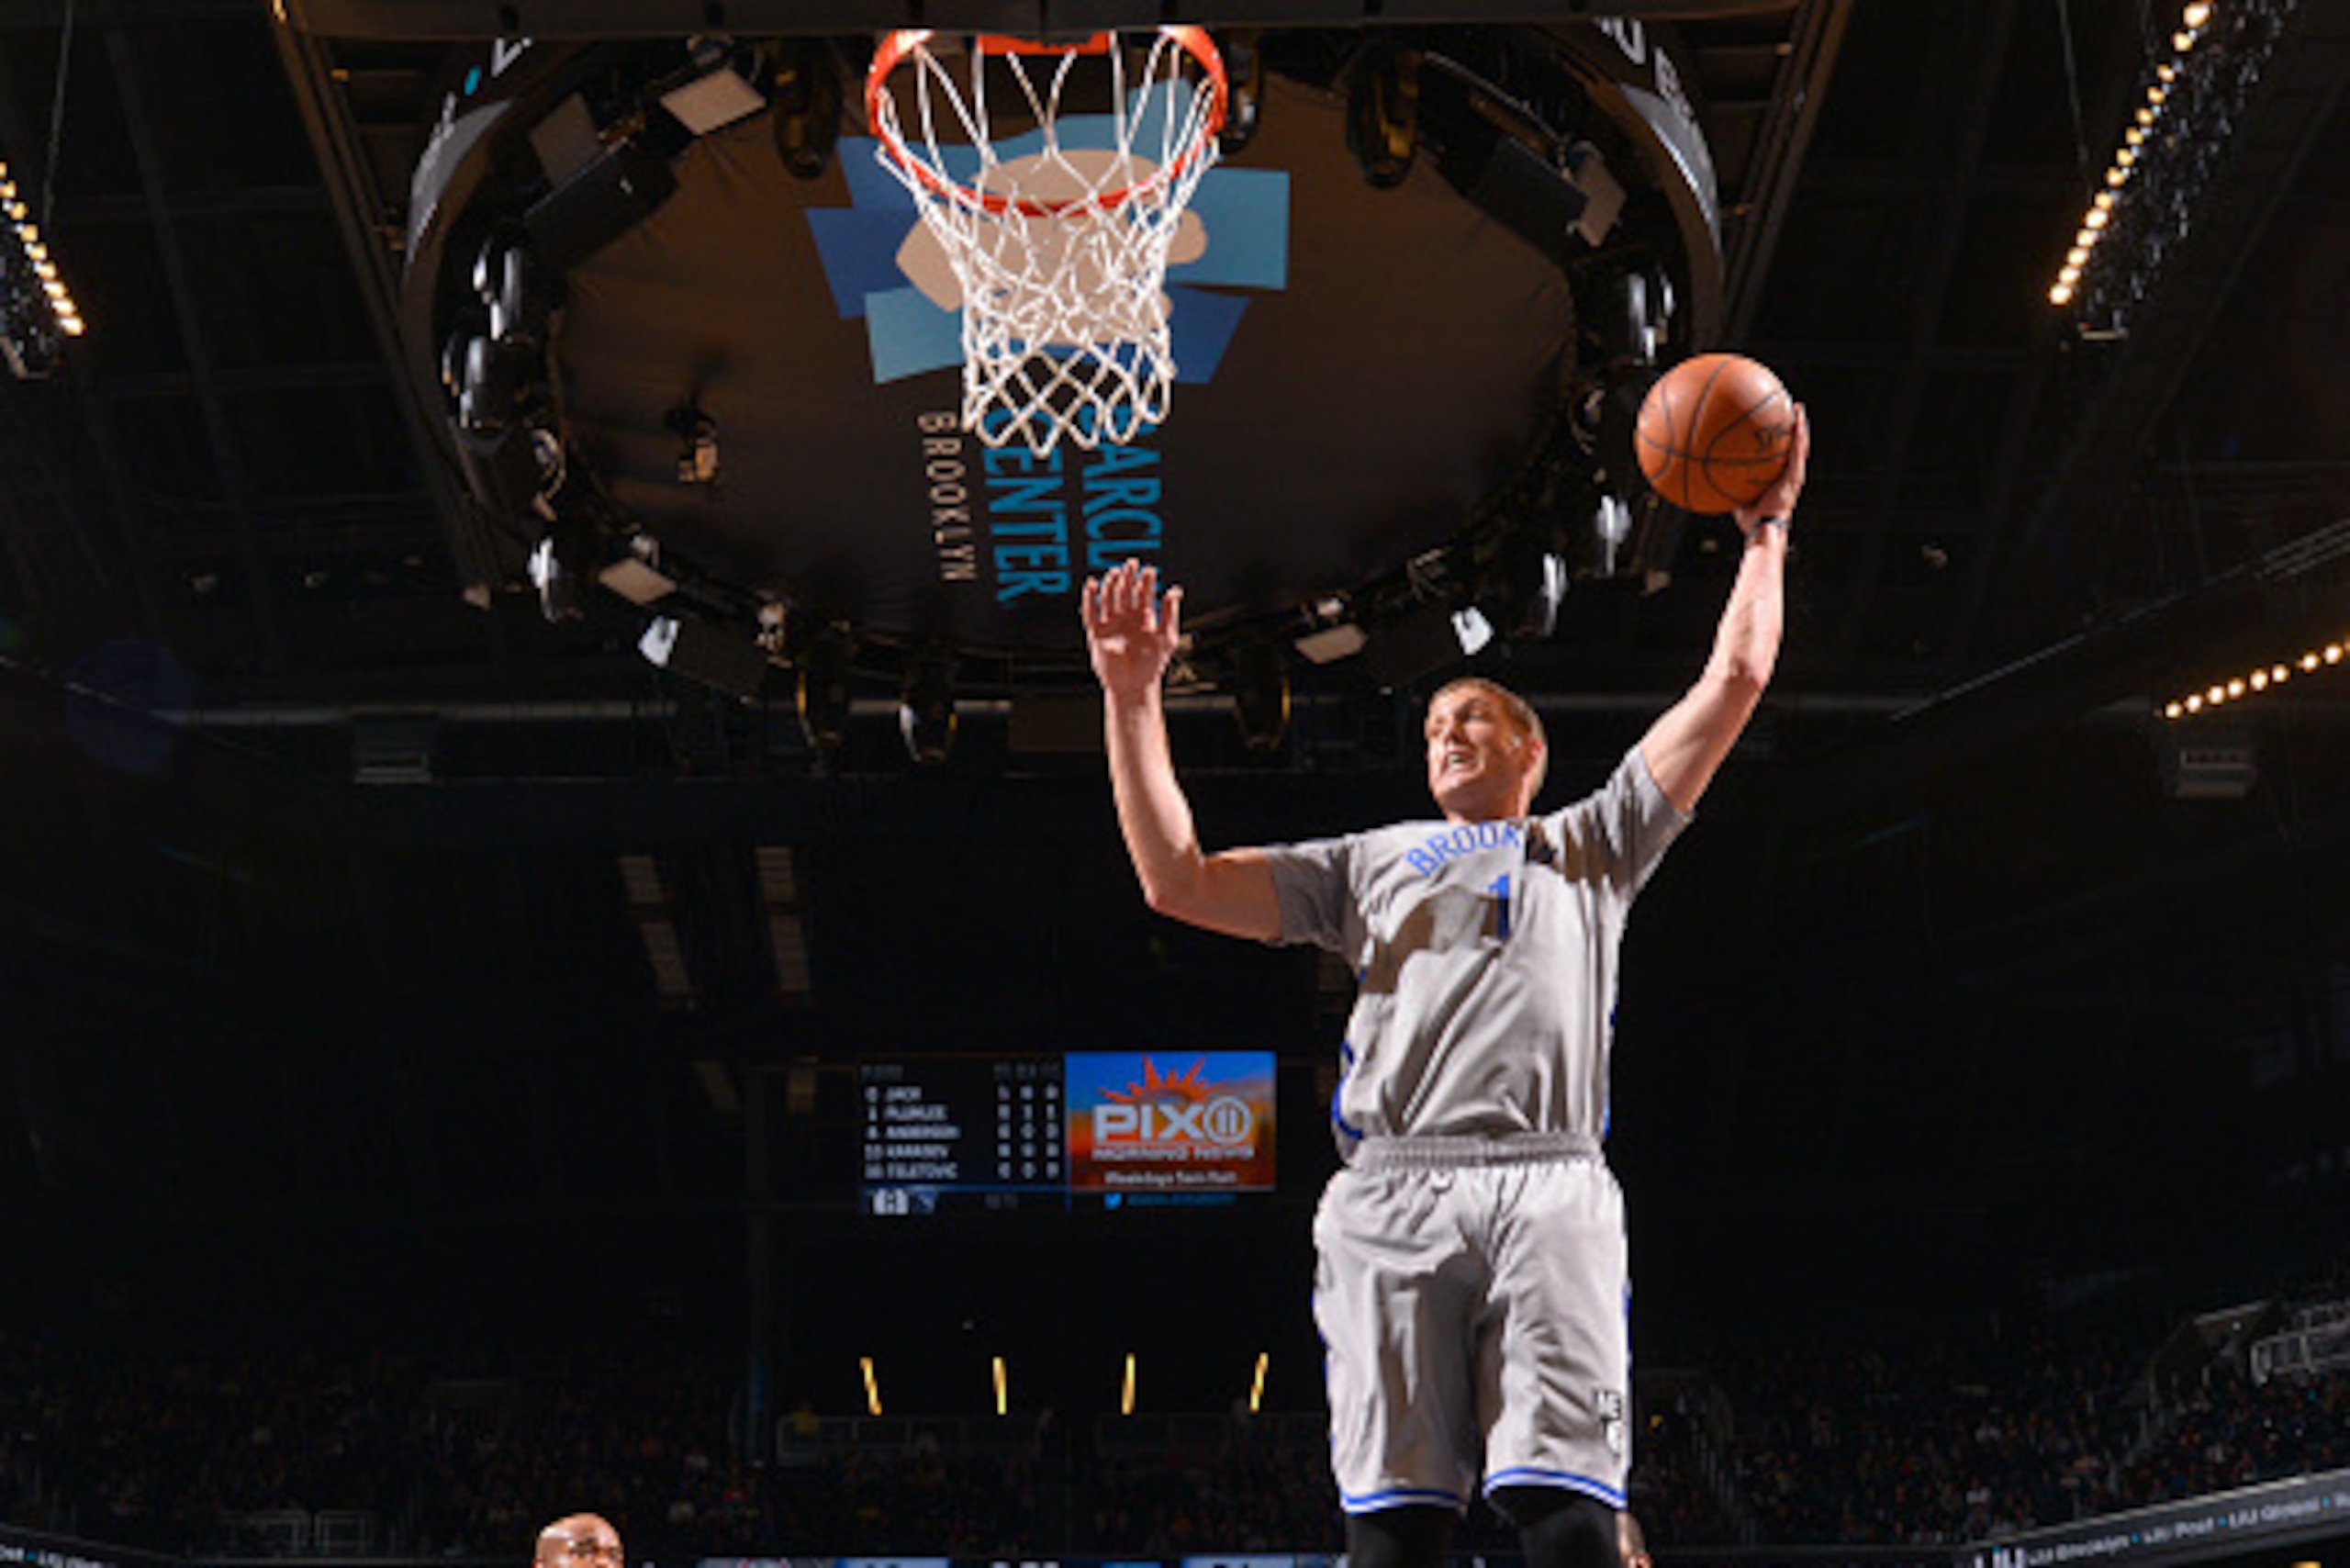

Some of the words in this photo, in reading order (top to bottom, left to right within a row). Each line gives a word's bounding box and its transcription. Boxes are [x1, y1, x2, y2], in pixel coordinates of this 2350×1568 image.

[918, 412, 978, 581] BROOKLYN
[981, 407, 1073, 608] CENTER
[1489, 873, 1511, 939] 1
